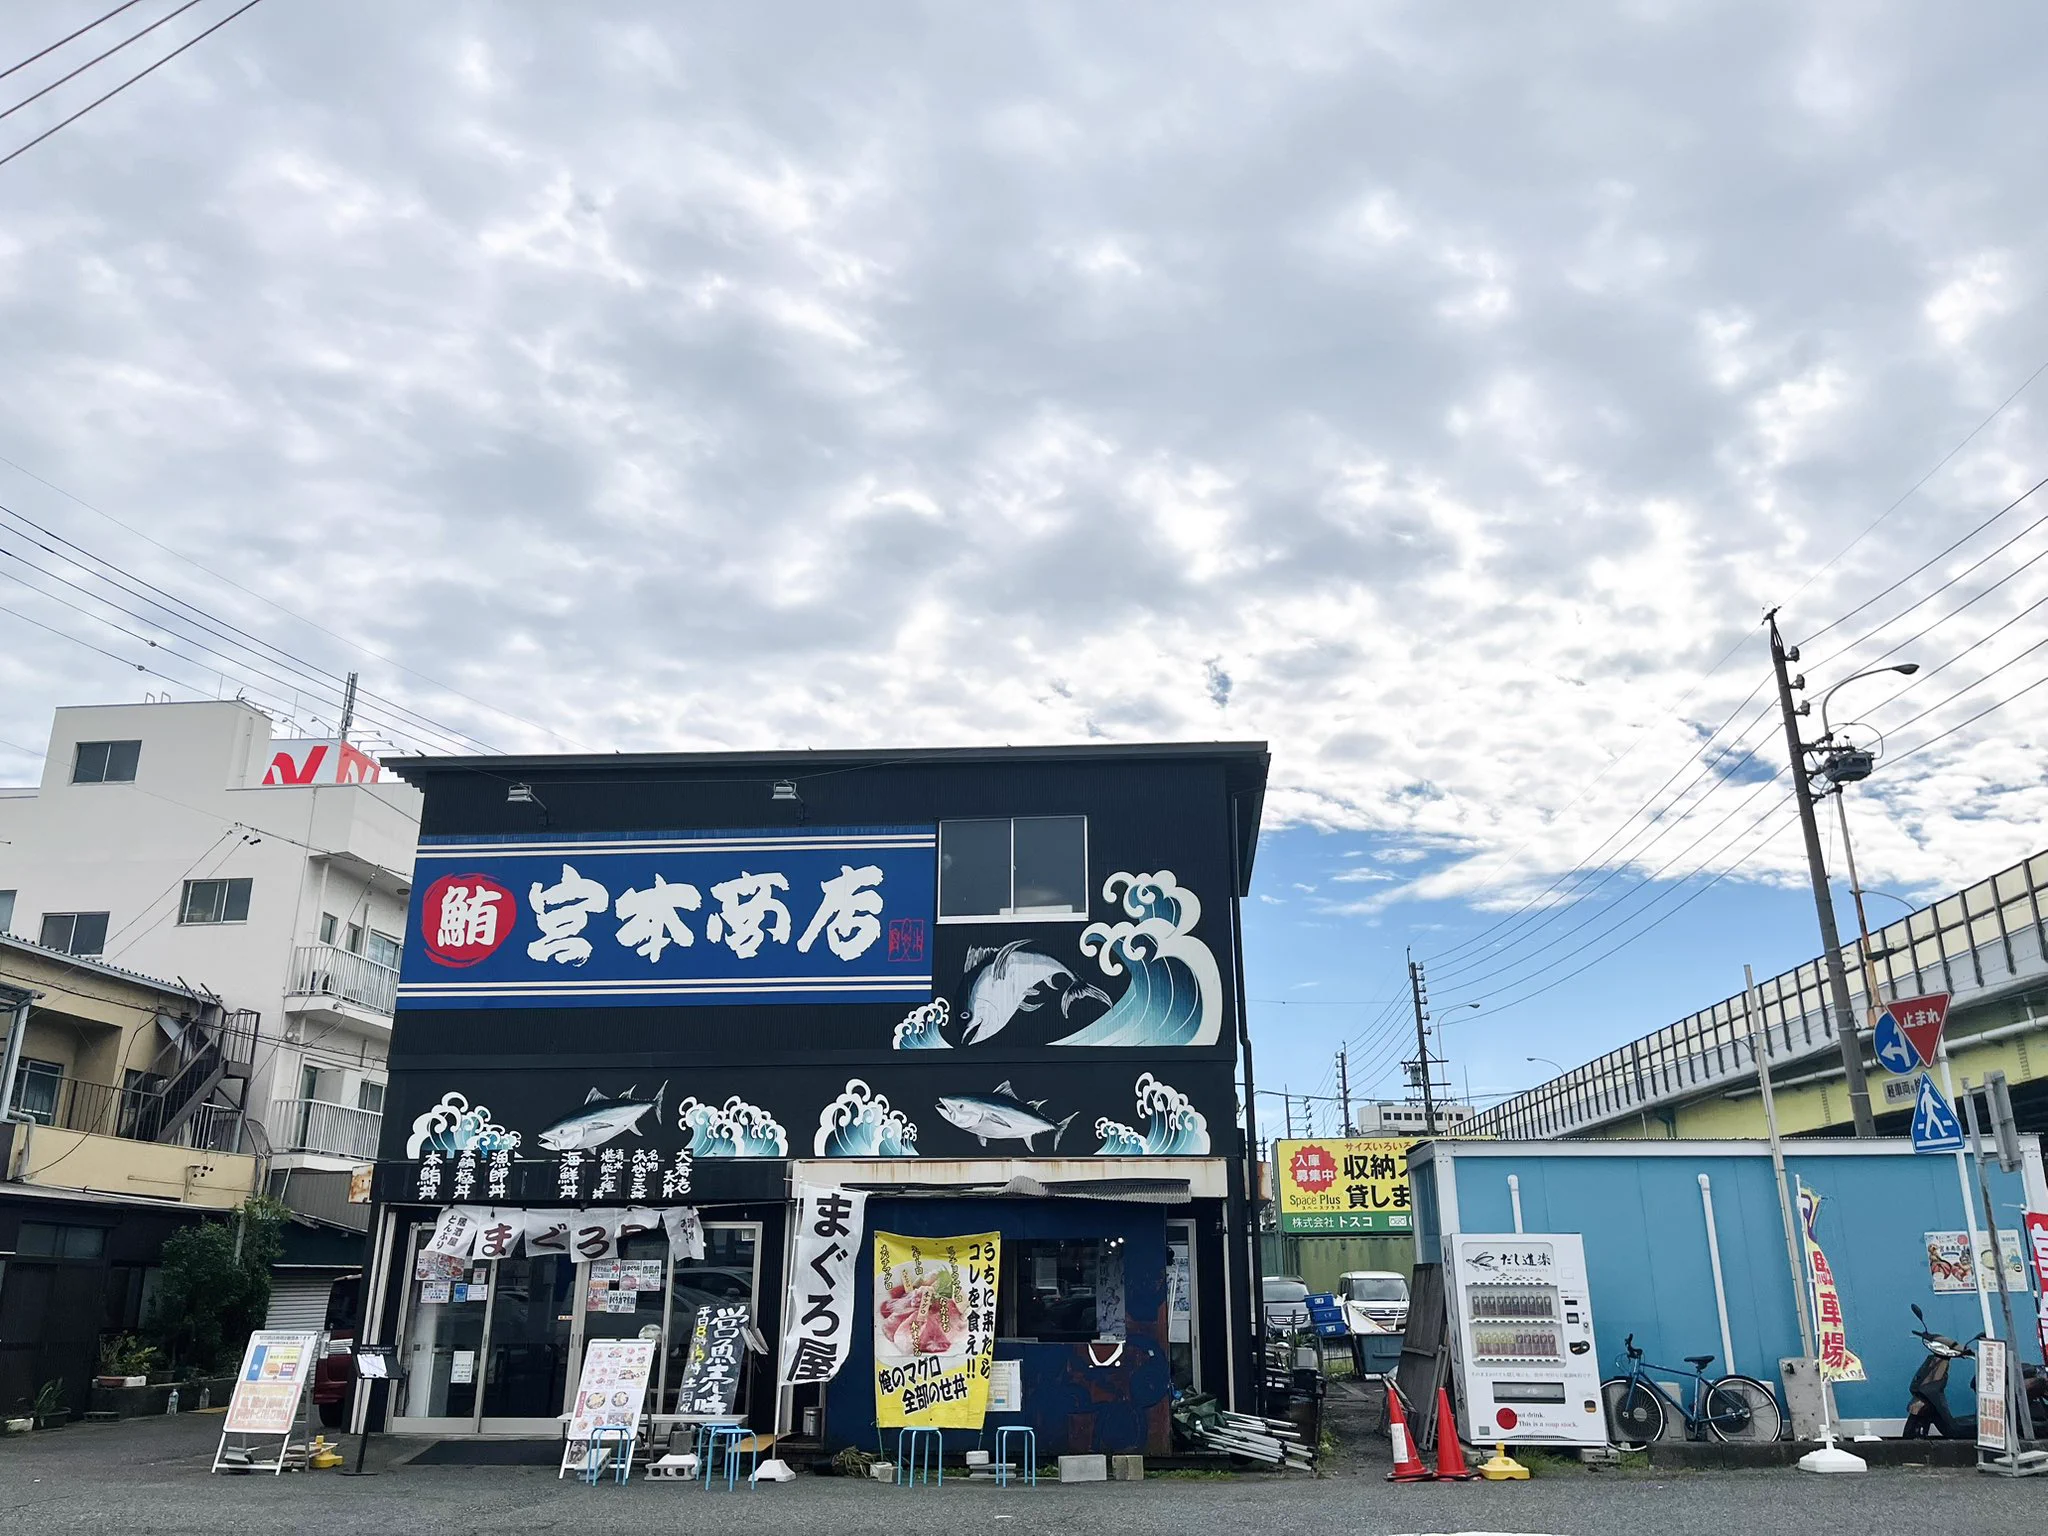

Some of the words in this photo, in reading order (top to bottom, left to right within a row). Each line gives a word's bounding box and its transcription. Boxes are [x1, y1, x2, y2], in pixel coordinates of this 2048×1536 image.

[438, 886, 498, 947] 鮪
[526, 863, 885, 968] 宮本商店
[1903, 1008, 1941, 1028] 止まれ
[1887, 1077, 1920, 1098] 軽車両を除
[417, 1150, 443, 1200] 本鮪丼
[488, 1149, 512, 1199] 漁師丼
[557, 1151, 585, 1199] 海鮮丼
[646, 1149, 659, 1172] 名物
[674, 1148, 693, 1194] 大海老
[1296, 1154, 1320, 1167] 入庫
[1296, 1168, 1334, 1182] 募集中
[661, 1169, 678, 1198] 天丼
[1289, 1194, 1317, 1207] Space
[1320, 1194, 1341, 1205] Plus
[482, 1222, 648, 1259] まぐろ
[1292, 1216, 1335, 1228] 株式会社
[1339, 1216, 1373, 1228] トスコ
[1500, 1253, 1551, 1266] だし道楽
[786, 1192, 852, 1382] まぐろ屋
[965, 1243, 981, 1379] コレを食え!!
[980, 1241, 996, 1380] うちに来たら
[879, 1355, 943, 1395] 俺のマグロ
[902, 1373, 968, 1415] 全部のせ丼
